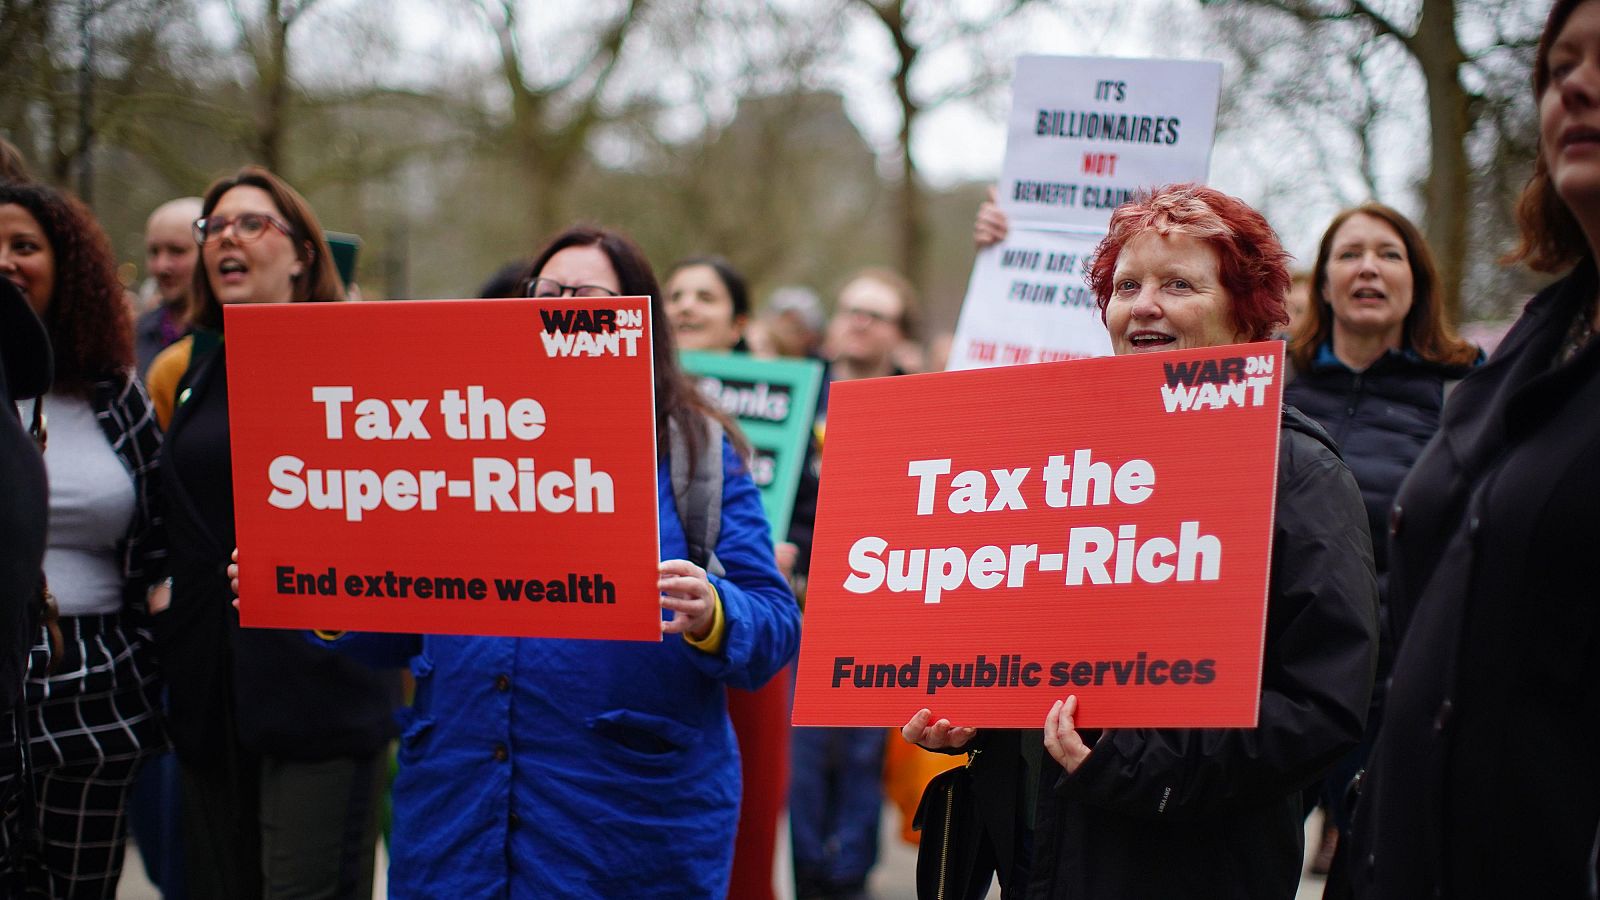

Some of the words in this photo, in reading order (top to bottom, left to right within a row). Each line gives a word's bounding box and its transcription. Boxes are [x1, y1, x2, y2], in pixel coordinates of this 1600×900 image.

[1095, 80, 1127, 101] IT'S
[1036, 110, 1181, 145] BILLIONAIRES
[1081, 152, 1118, 176] NOT
[1013, 180, 1078, 207] BENEFIT
[1001, 250, 1041, 270] WHO
[1046, 253, 1076, 273] ARE
[1009, 281, 1059, 304] FROM
[540, 309, 616, 334] WAR
[615, 309, 642, 328] ON
[540, 328, 643, 358] WANT
[1163, 357, 1246, 387] WAR
[1244, 354, 1274, 375] ON
[1161, 376, 1273, 412] WANT
[313, 386, 430, 440] Tax
[440, 386, 546, 440] the
[267, 455, 615, 522] Super-Rich
[908, 459, 1031, 515] Tax
[1043, 448, 1155, 508] the
[843, 521, 1222, 604] Super-Rich
[276, 566, 337, 597] End
[344, 571, 488, 601] extreme
[494, 573, 616, 604] wealth
[831, 655, 922, 688] Fund
[926, 654, 1042, 694] public
[1049, 651, 1216, 687] services
